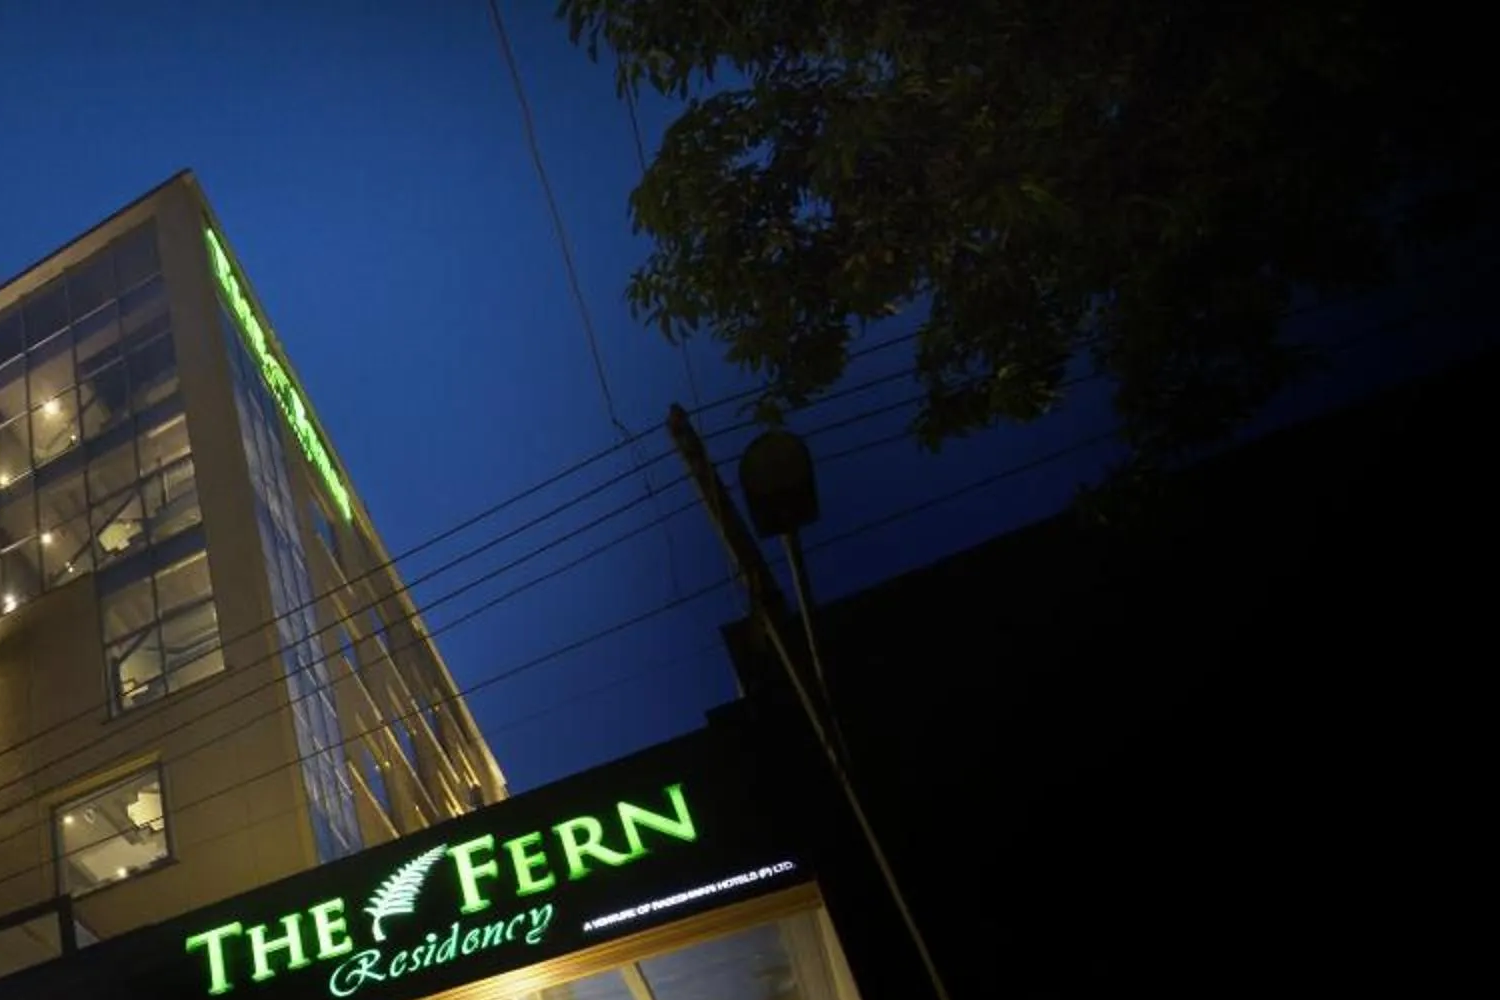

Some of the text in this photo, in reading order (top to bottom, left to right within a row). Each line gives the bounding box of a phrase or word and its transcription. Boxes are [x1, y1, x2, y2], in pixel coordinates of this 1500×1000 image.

[186, 783, 696, 996] THE FERN
[637, 903, 650, 915] OF
[716, 871, 759, 891] HOTELS
[329, 903, 553, 998] Residency
